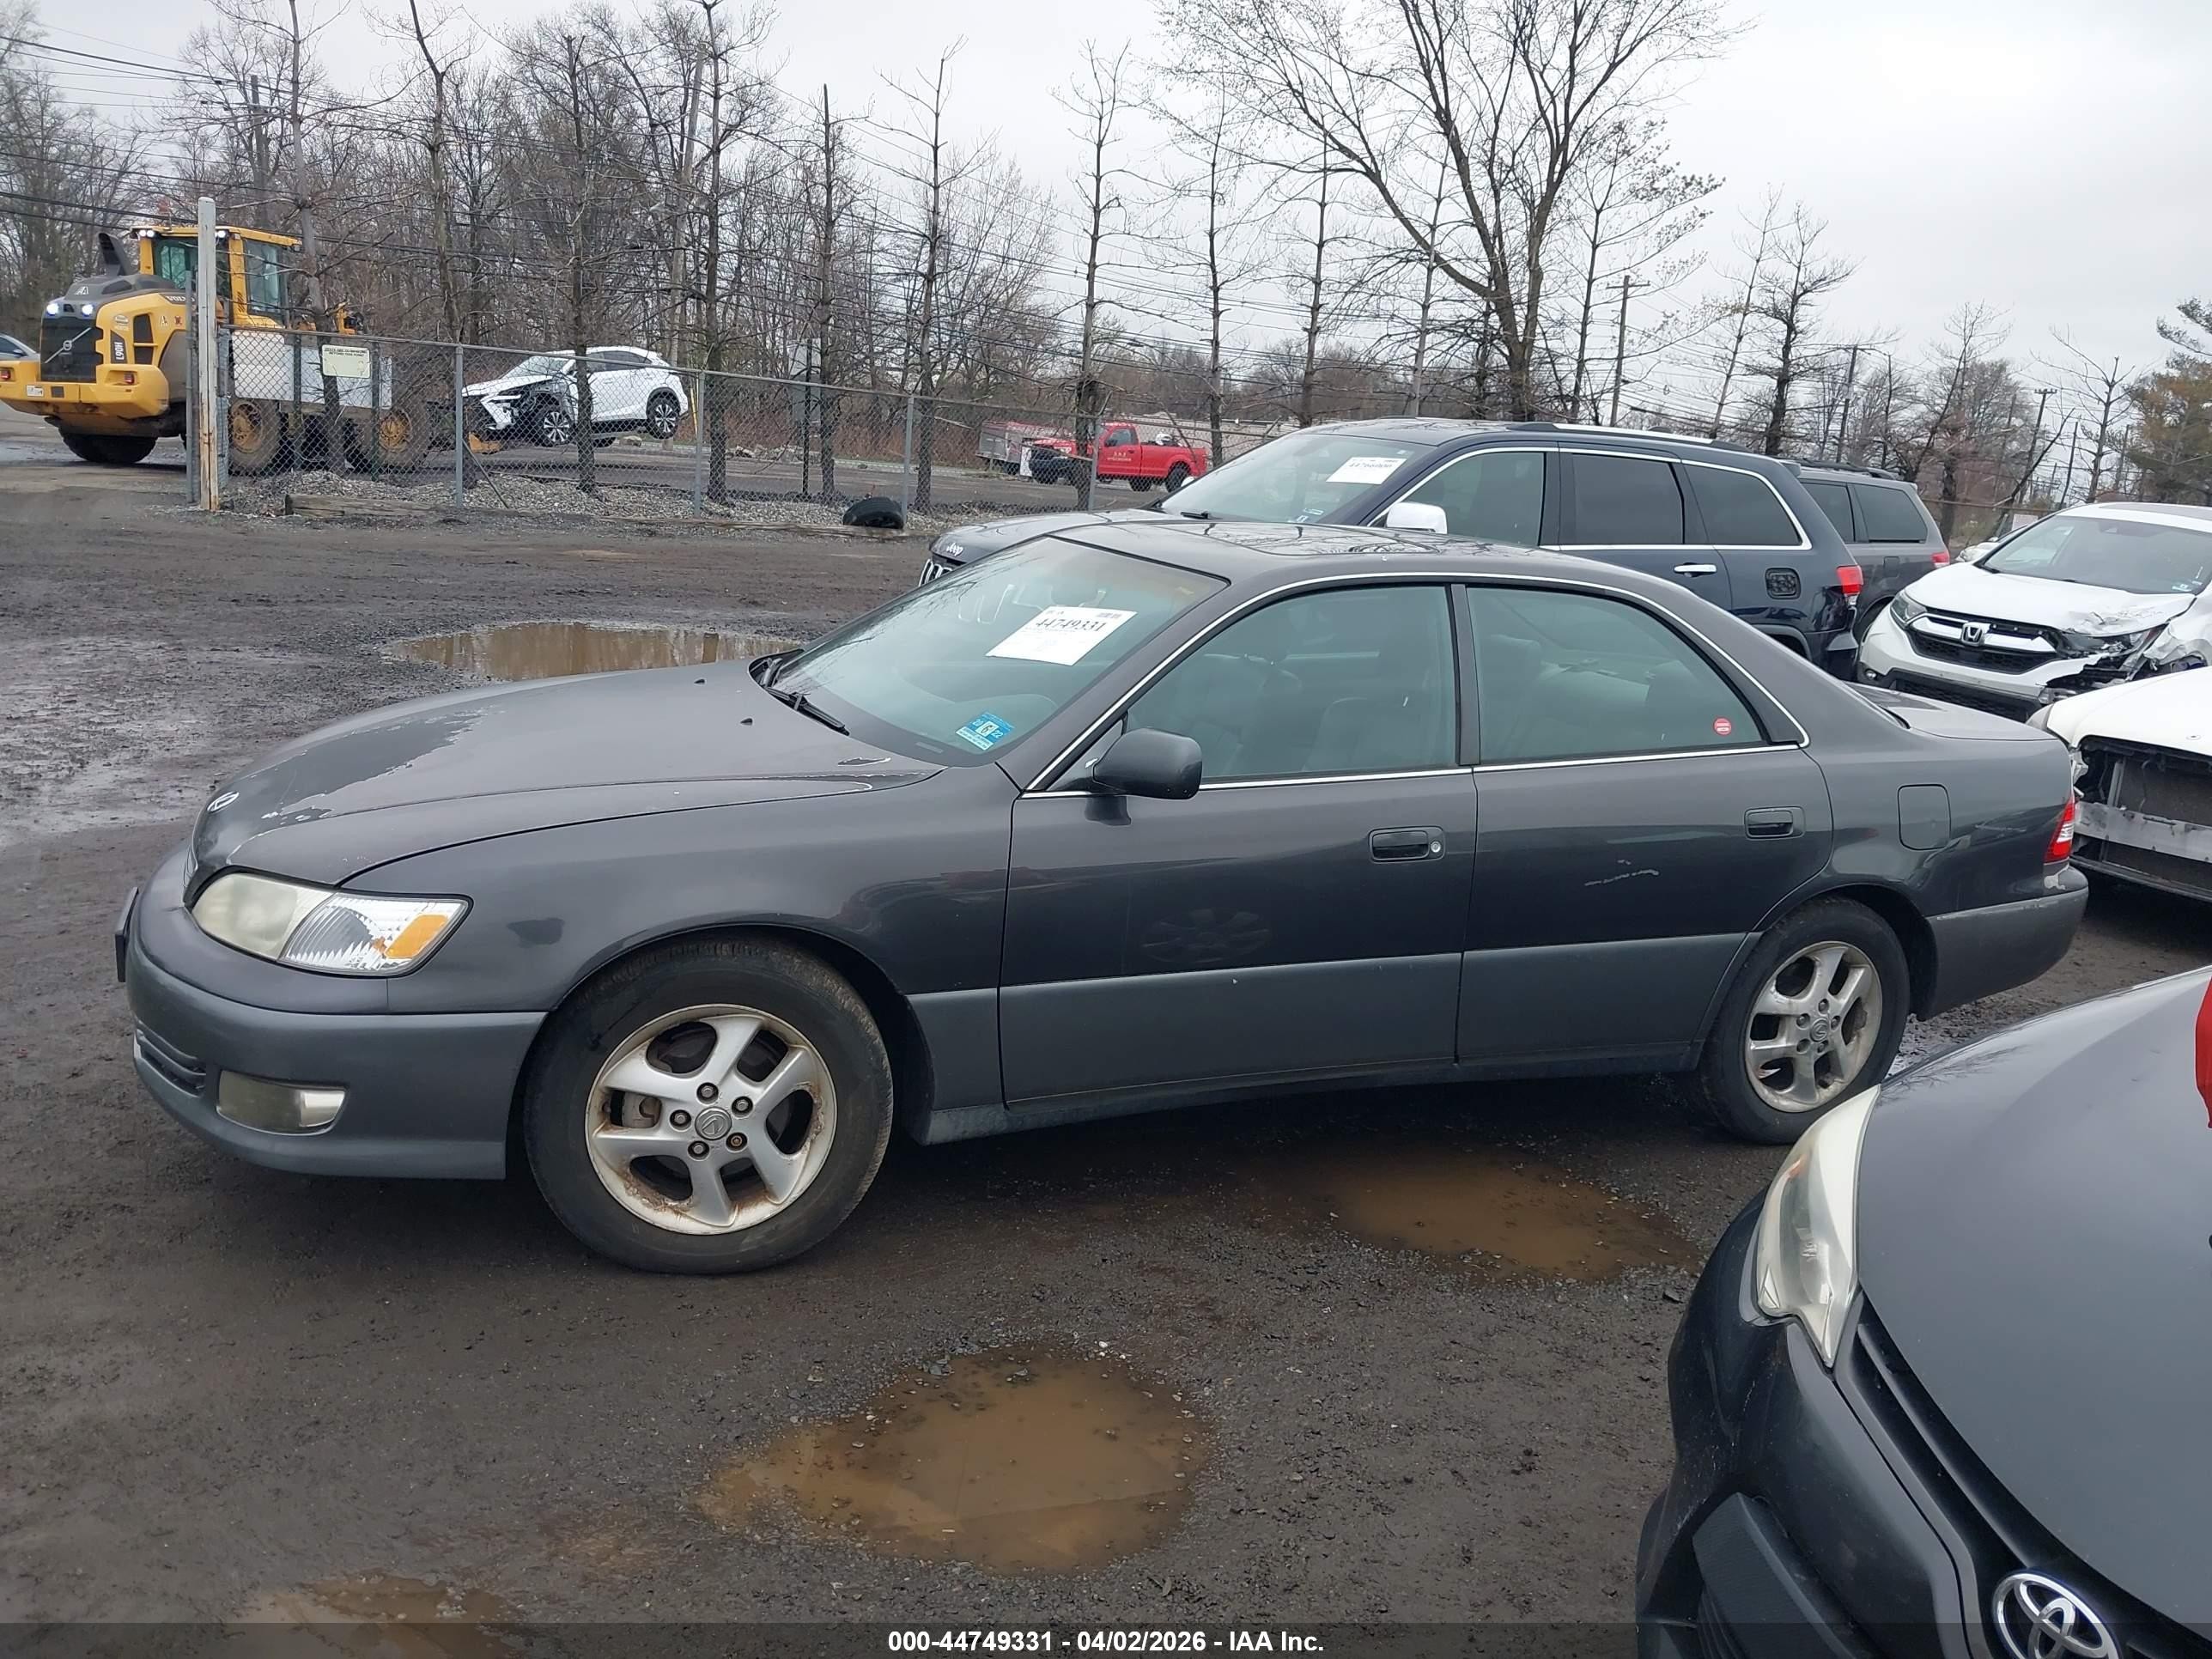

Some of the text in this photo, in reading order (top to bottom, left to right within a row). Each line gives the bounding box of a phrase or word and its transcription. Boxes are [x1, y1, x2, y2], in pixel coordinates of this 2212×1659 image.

[114, 341, 125, 361] L90H
[945, 542, 963, 557] Jeep
[1036, 618, 1108, 632] 44749331
[981, 725, 993, 734] 6
[991, 730, 1004, 738] 22
